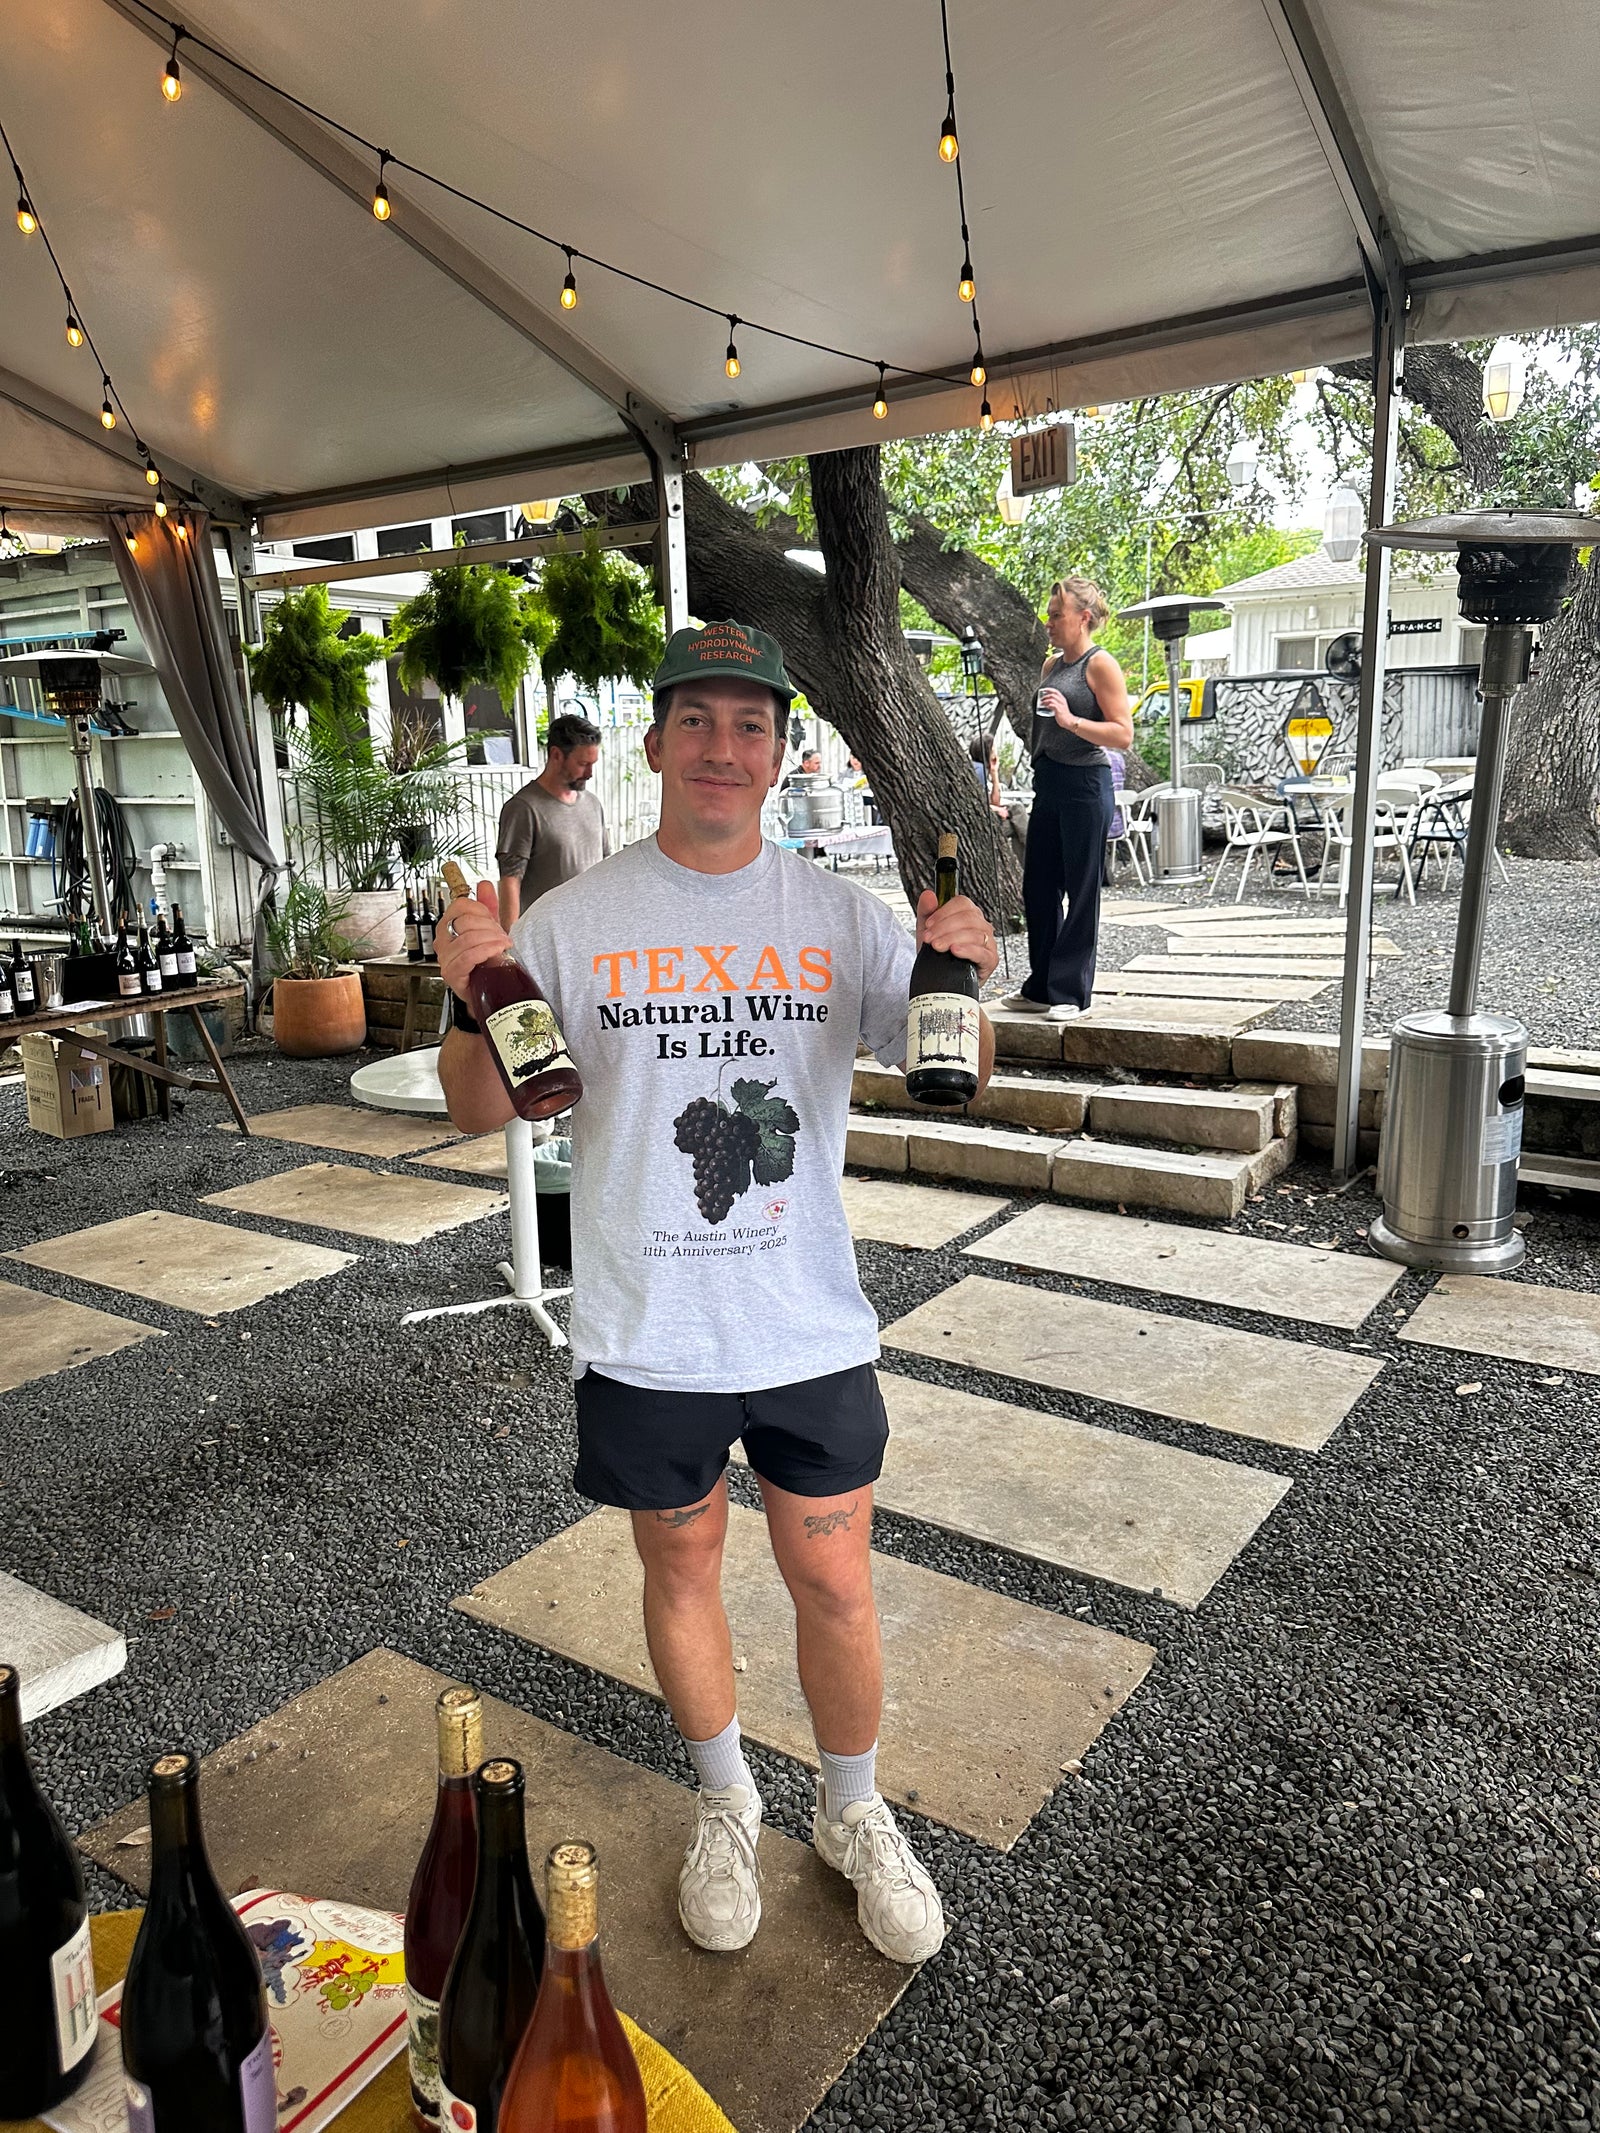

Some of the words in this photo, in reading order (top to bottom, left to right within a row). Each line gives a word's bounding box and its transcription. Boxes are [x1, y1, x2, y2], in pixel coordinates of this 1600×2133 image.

[1020, 427, 1058, 482] EXIT
[703, 625, 747, 640] WESTERN
[688, 638, 764, 657] HYDRODYNAMIC
[700, 651, 752, 664] RESEARCH
[593, 945, 833, 999] TEXAS
[597, 996, 734, 1031] Natural
[744, 994, 829, 1023] Wine
[656, 1033, 687, 1059] Is
[698, 1030, 775, 1058] Life.
[652, 1231, 679, 1242] The
[682, 1230, 727, 1241] Austin
[731, 1224, 780, 1240] Winery
[643, 1246, 667, 1257] 11th
[671, 1243, 756, 1257] Anniversary
[759, 1234, 788, 1251] 2025
